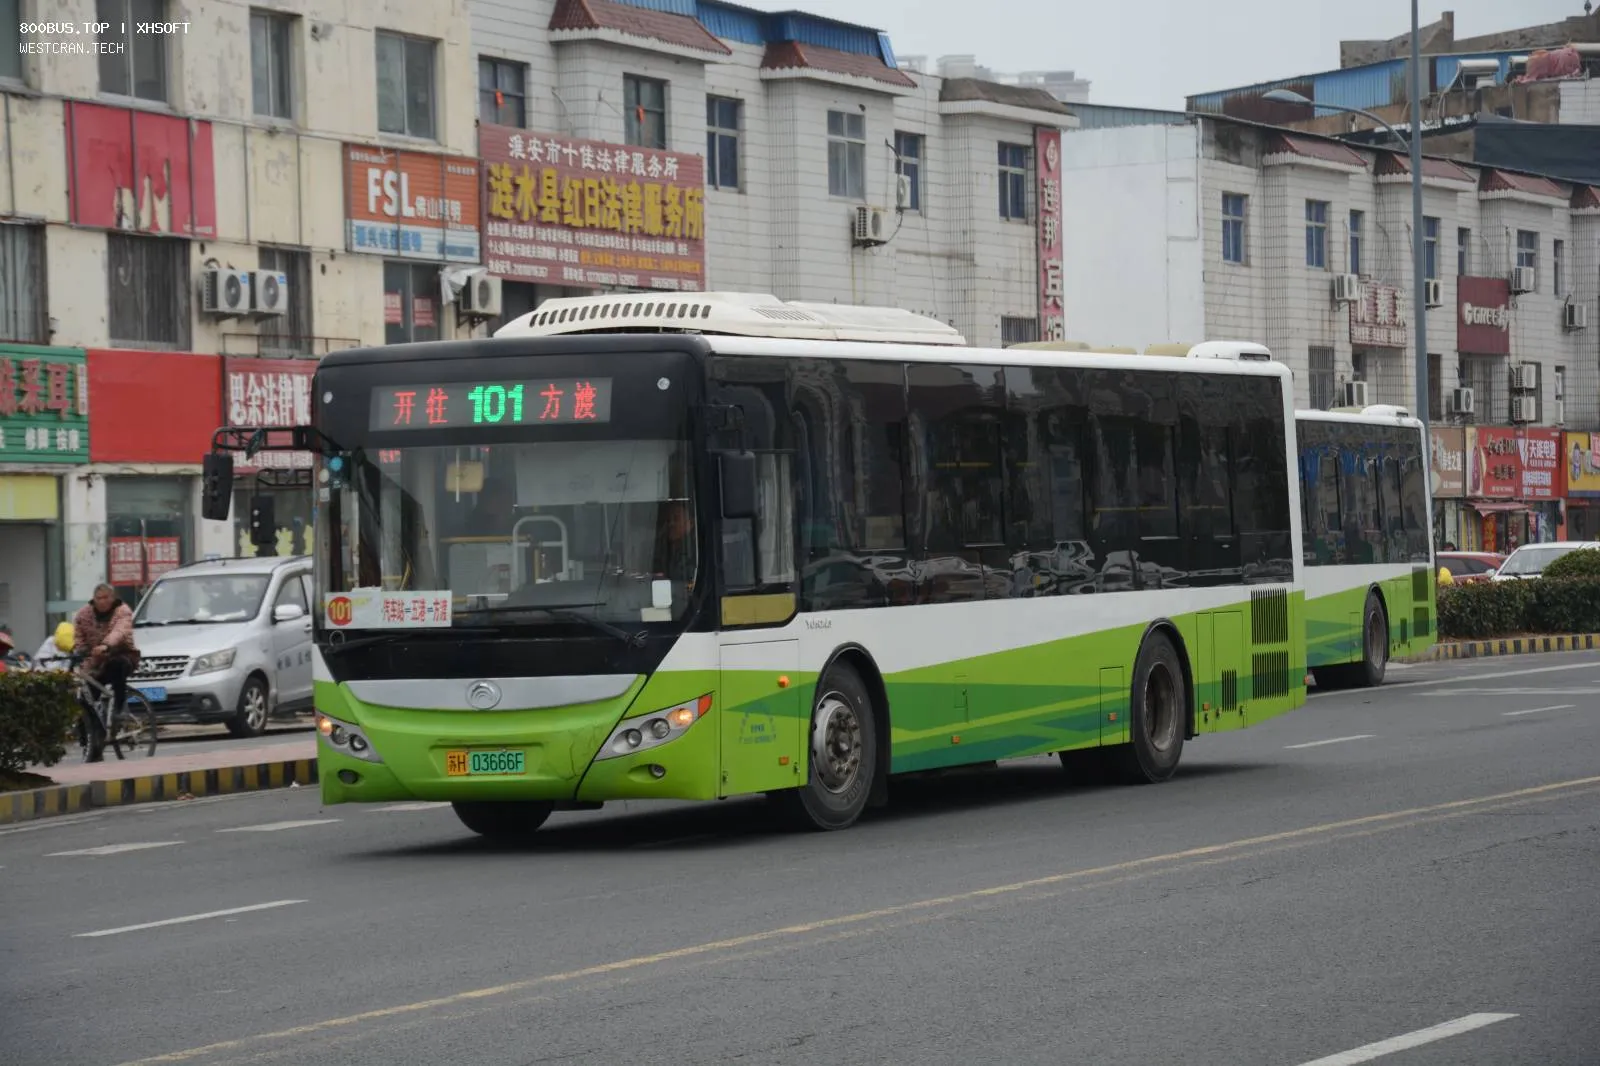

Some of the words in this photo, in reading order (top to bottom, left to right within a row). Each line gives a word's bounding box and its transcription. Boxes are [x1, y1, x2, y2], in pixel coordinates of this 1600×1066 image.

[508, 134, 679, 181] 淮安市十佳法律服务所
[368, 167, 416, 217] FSL
[488, 162, 704, 240] 涟水县红日法律服务所
[1473, 306, 1498, 325] GREE
[393, 388, 449, 425] 开往
[467, 384, 524, 423] 101
[540, 381, 597, 420] 方渡
[329, 600, 352, 621] 101
[472, 752, 523, 771] 03666F
